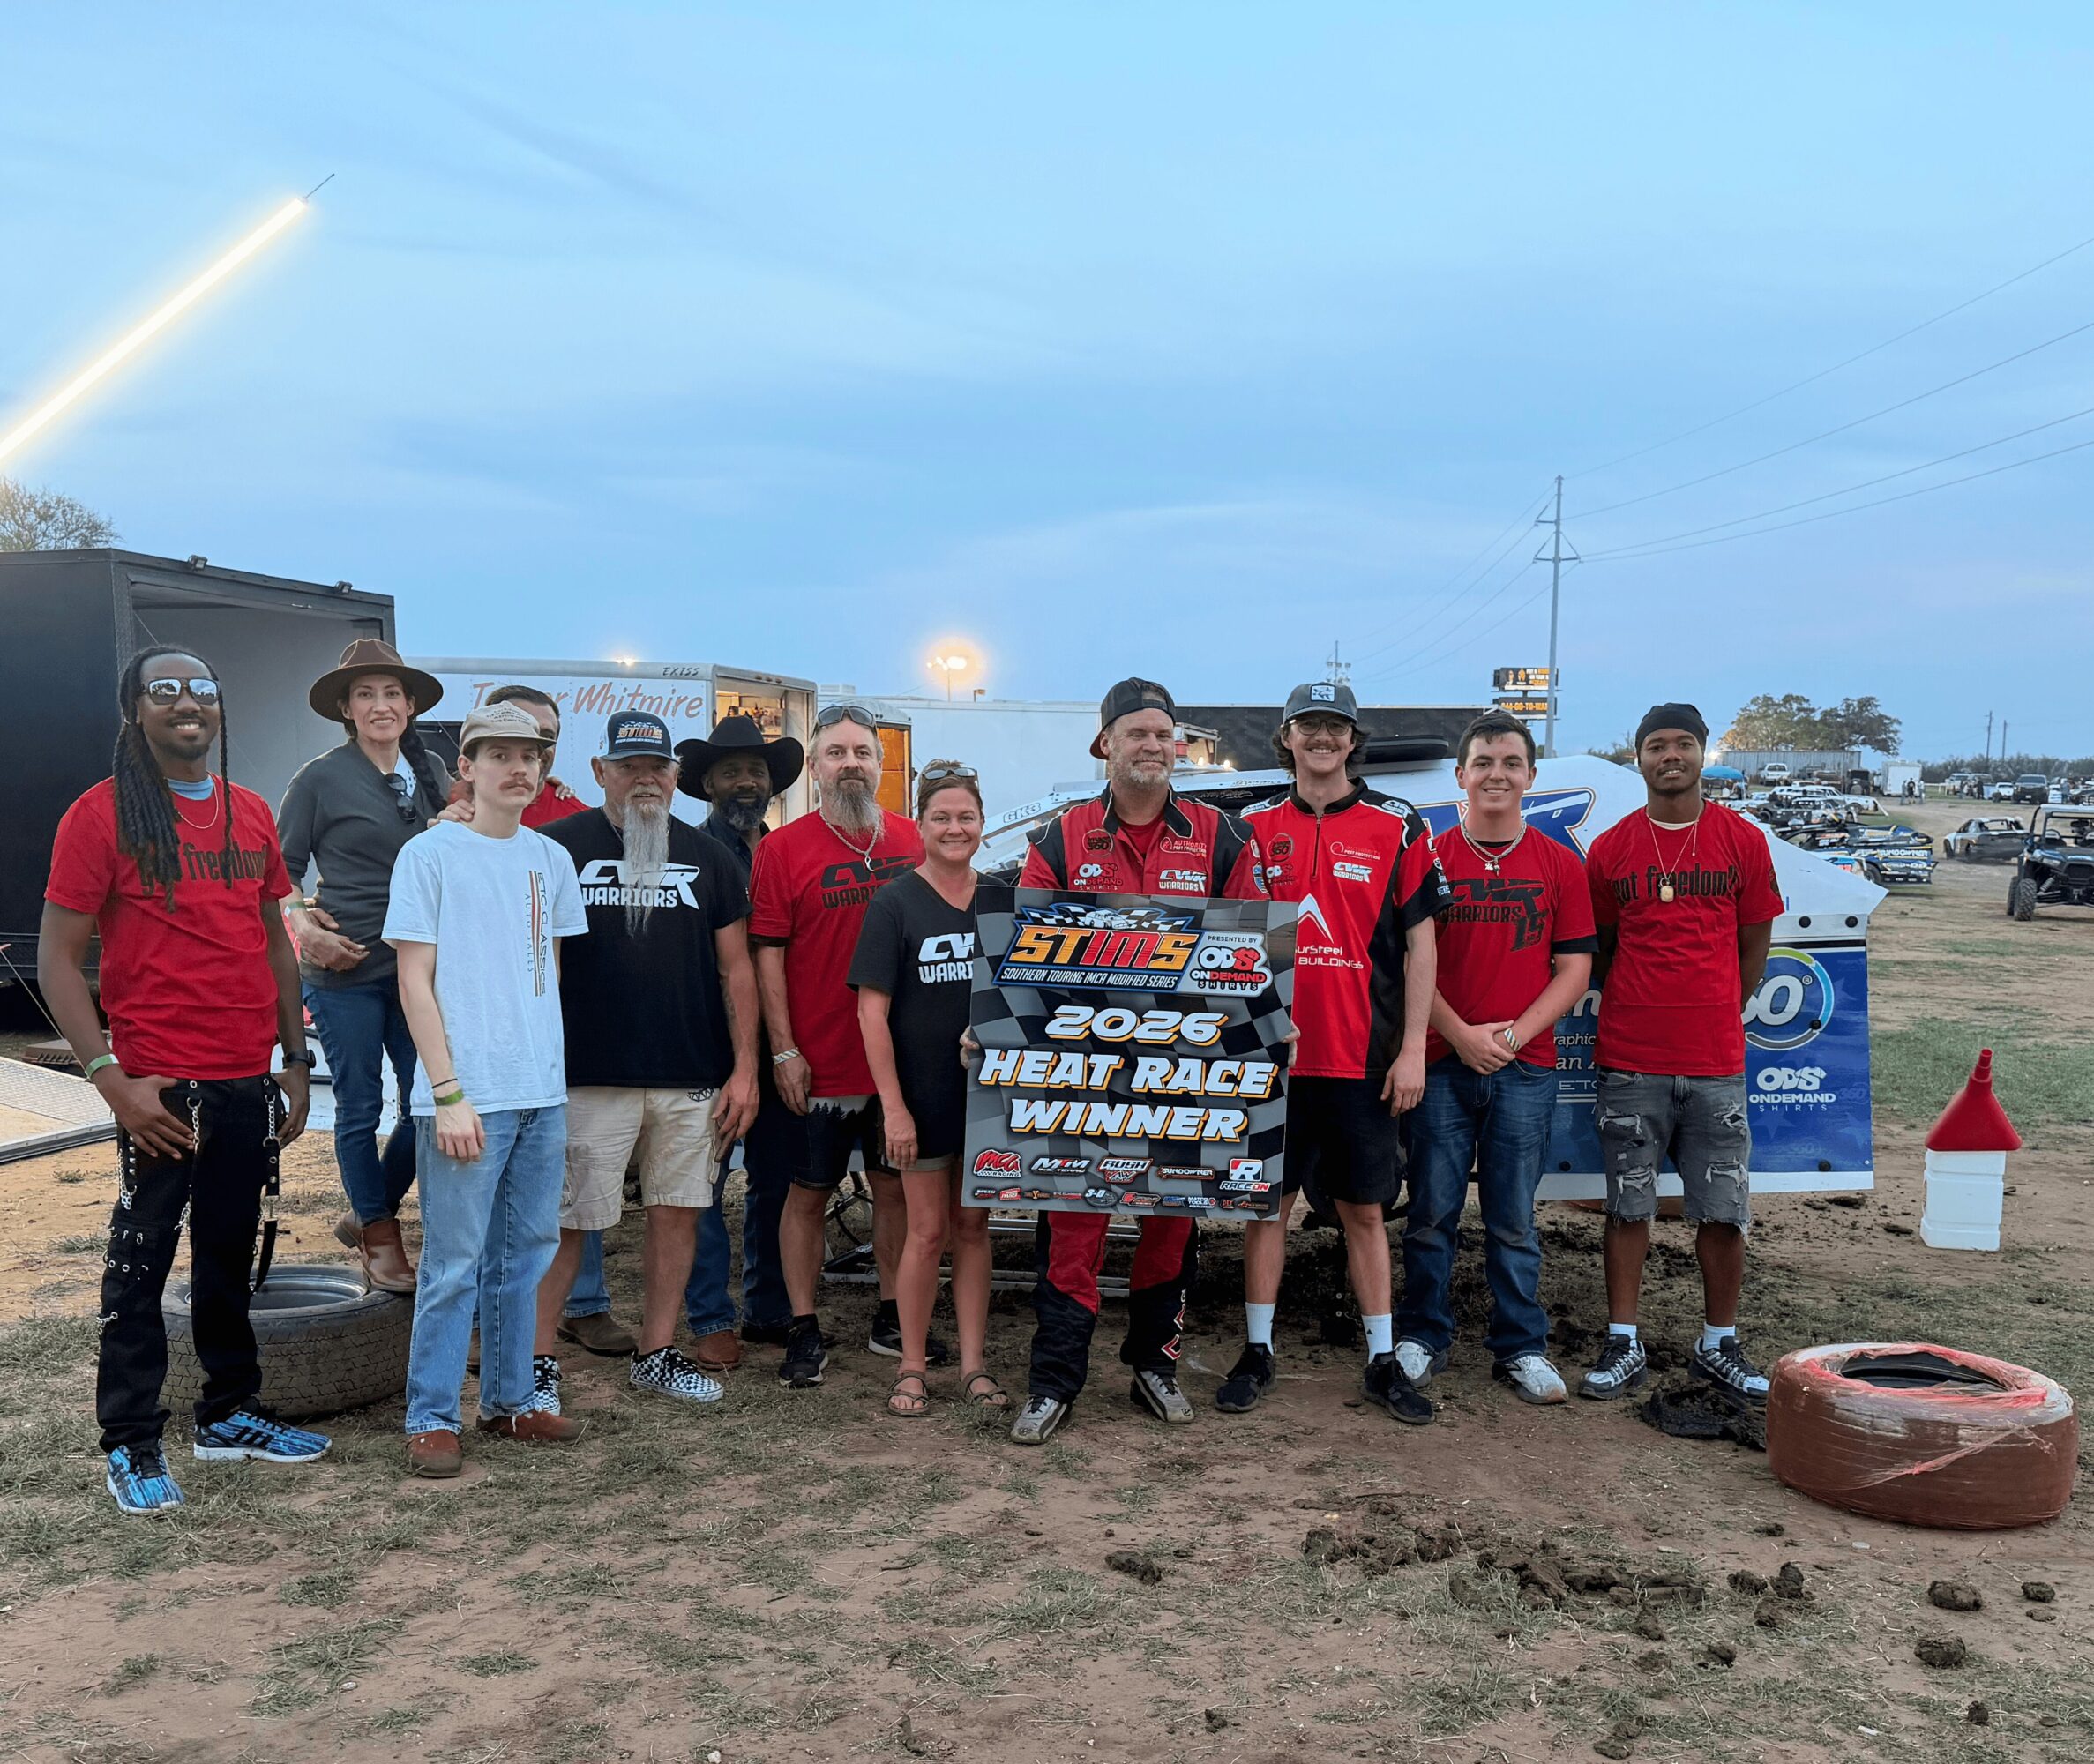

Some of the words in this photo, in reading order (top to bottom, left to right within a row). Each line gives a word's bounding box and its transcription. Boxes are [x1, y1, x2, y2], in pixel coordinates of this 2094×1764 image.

[574, 682, 703, 719] Whitmire
[1003, 802, 1041, 823] GK3
[1159, 882, 1199, 892] WARRIORS
[582, 887, 678, 908] WARRIORS
[1207, 935, 1246, 944] PRESENTED
[1009, 925, 1199, 971] STIMS
[1295, 945, 1343, 956] urSteel
[1198, 946, 1261, 971] ODS
[1298, 957, 1364, 969] BUILDINGS
[1000, 968, 1049, 981] SOUTHERN
[1048, 969, 1086, 983] TOURING
[1086, 971, 1105, 984] IMCA
[1105, 973, 1148, 987] MODIFIED
[1147, 975, 1178, 988] SERIES
[1191, 970, 1267, 983] ONDEMAND
[1199, 981, 1259, 990] SHIRTS
[1045, 1005, 1229, 1046] 2026
[978, 1049, 1125, 1091] HEAT
[1131, 1056, 1279, 1099] RACE
[1756, 1066, 1827, 1091] ODS
[1749, 1093, 1836, 1103] ONDEMAND
[1759, 1103, 1827, 1112] SHIRTS
[1010, 1098, 1248, 1143] WINNER
[1103, 1160, 1148, 1170] RUSH
[1163, 1167, 1213, 1176] SUNDOWNER
